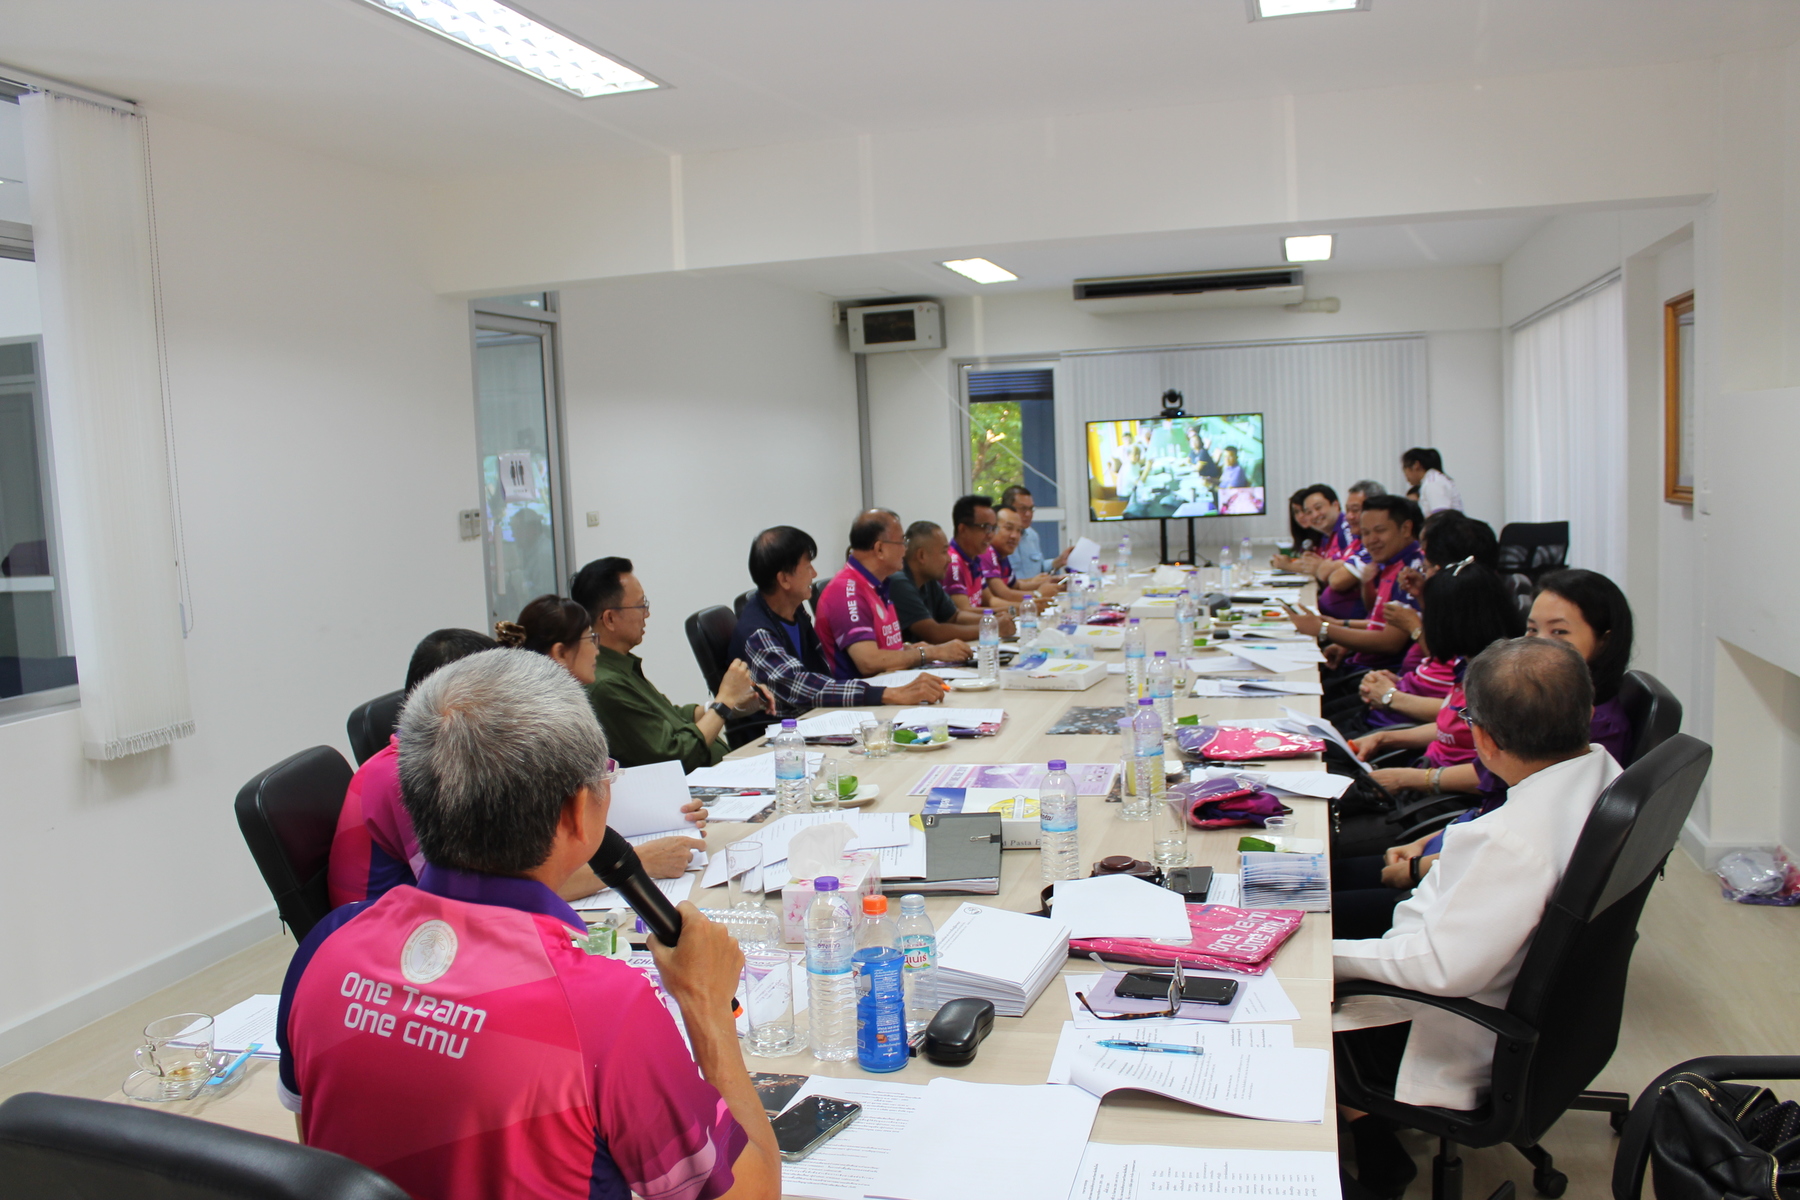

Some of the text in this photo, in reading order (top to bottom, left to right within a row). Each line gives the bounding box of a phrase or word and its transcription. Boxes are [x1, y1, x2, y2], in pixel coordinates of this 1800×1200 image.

[848, 600, 859, 622] ONE
[340, 972, 487, 1033] One Team
[344, 1002, 397, 1037] One
